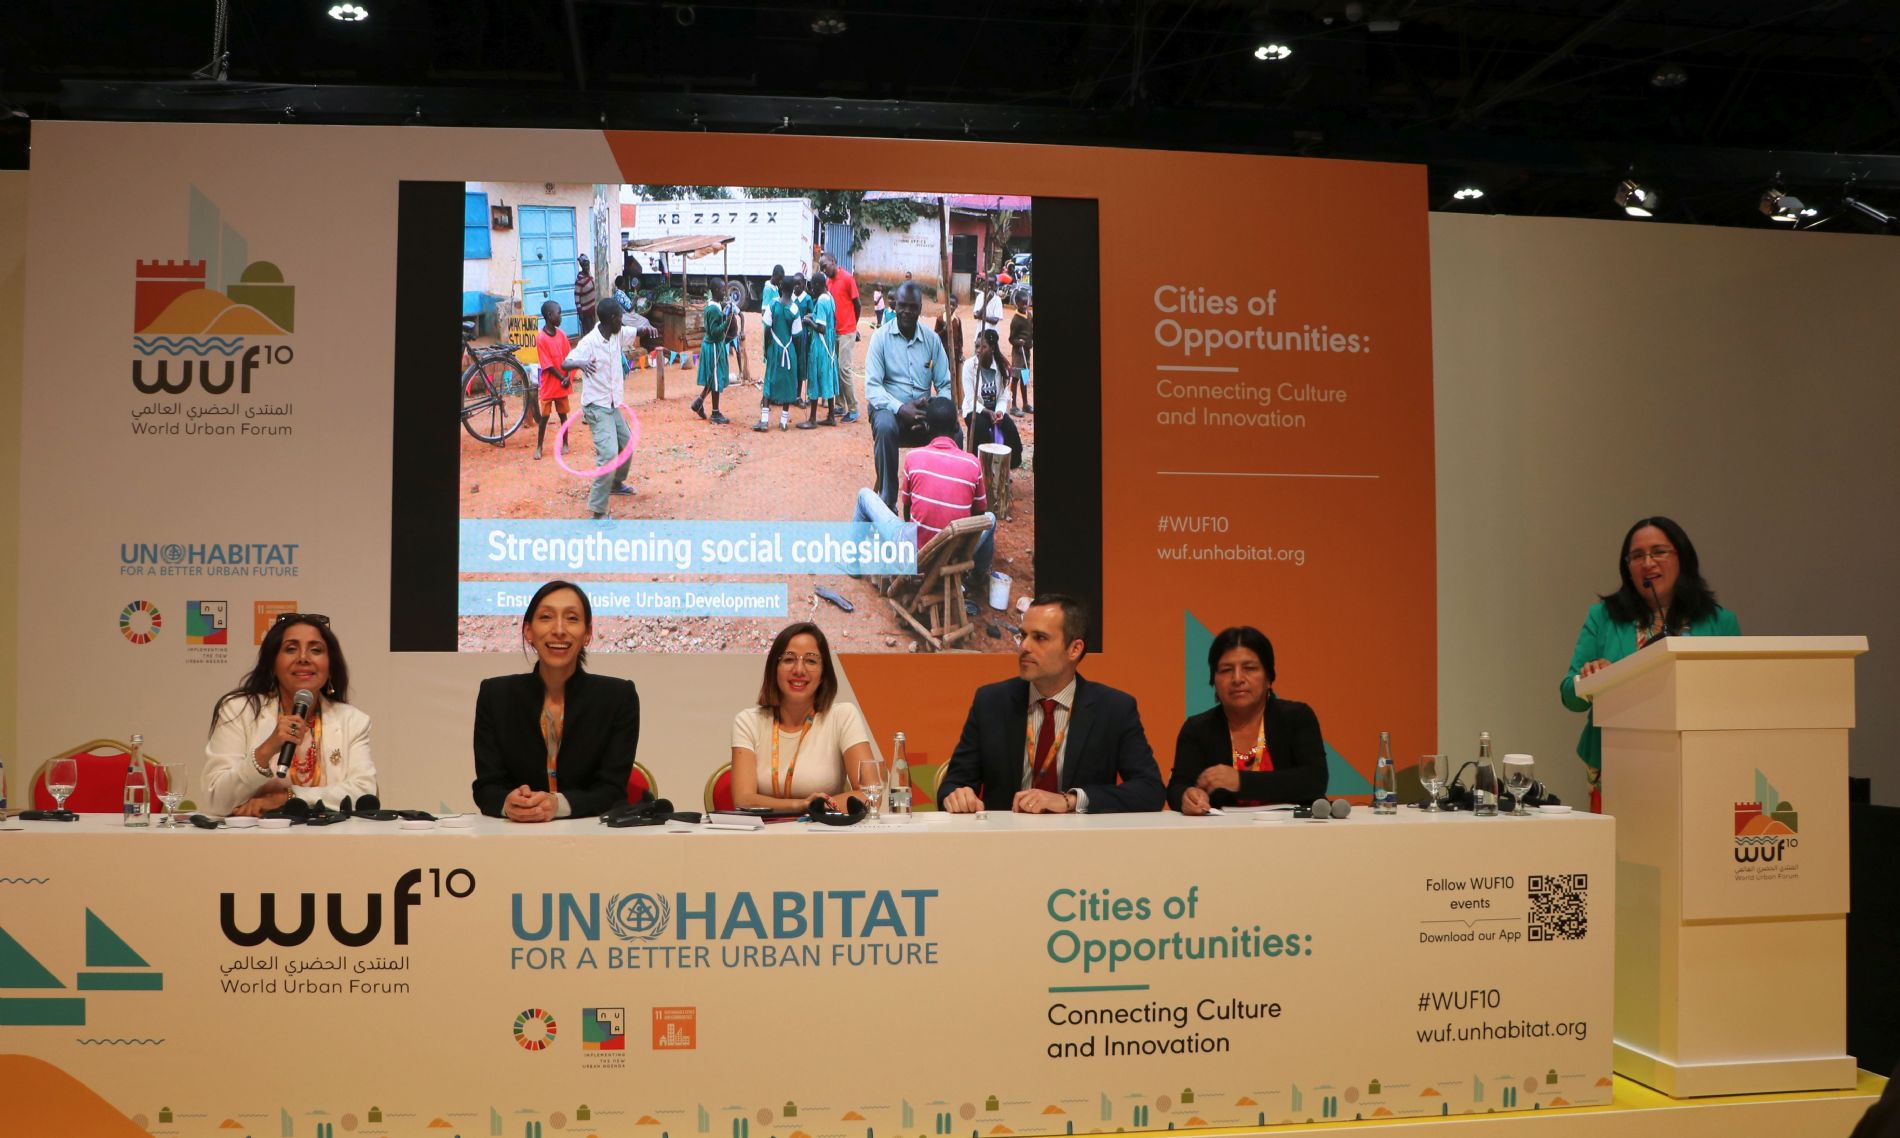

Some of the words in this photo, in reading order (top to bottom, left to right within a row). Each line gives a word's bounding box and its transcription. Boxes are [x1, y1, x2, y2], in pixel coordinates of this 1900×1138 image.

[1154, 285, 1238, 315] Cities
[1248, 289, 1276, 316] of
[509, 333, 536, 347] STUDIO
[1155, 319, 1370, 356] Opportunities:
[1156, 379, 1271, 406] Connecting
[1277, 383, 1347, 402] Culture
[131, 403, 181, 419] العالمي
[186, 403, 239, 420] الحضري
[245, 403, 292, 416] المنتدى
[1157, 408, 1196, 425] and
[1204, 408, 1305, 428] Innovation
[132, 423, 179, 435] World
[185, 423, 235, 435] Urban
[241, 423, 292, 436] Forum
[1158, 516, 1229, 533] #WUF10
[120, 543, 158, 564] UN
[188, 543, 299, 565] HABITAT
[488, 531, 692, 569] Strengthening
[701, 533, 782, 563] social
[791, 531, 916, 564] cohesion
[1157, 544, 1305, 566] wuf.unhabitat.org
[120, 566, 143, 576] FOR
[147, 566, 156, 576] A
[160, 566, 202, 576] BETTER
[207, 566, 249, 576] URBAN
[253, 566, 298, 576] FUTURE
[636, 592, 680, 608] Urban
[685, 592, 780, 612] Development
[1426, 878, 1466, 891] Follow
[1470, 876, 1514, 890] WUF10
[1047, 887, 1151, 922] Cities
[1163, 886, 1198, 920] of
[1450, 898, 1490, 909] events
[511, 892, 600, 941] UN
[676, 889, 939, 940] HABITAT
[1420, 931, 1474, 943] Download
[1478, 932, 1495, 941] our
[1499, 929, 1521, 943] App
[511, 947, 566, 970] FOR
[576, 947, 598, 970] A
[608, 946, 711, 969] BETTER
[722, 944, 820, 968] URBAN
[832, 942, 939, 966] FUTURE
[1047, 925, 1312, 973] Opportunities:
[220, 956, 278, 977] العالمي
[284, 956, 346, 977] الحضري
[353, 956, 409, 974] المنتدى
[220, 979, 276, 993] World
[284, 979, 342, 993] Urban
[350, 979, 409, 993] Forum
[1418, 989, 1500, 1011] #WUF10
[1048, 1001, 1188, 1028] Connecting
[1197, 998, 1282, 1021] Culture
[1417, 1020, 1587, 1043] wuf.unhabitat.org
[1047, 1036, 1095, 1058] and
[1105, 1033, 1230, 1056] Innovation
